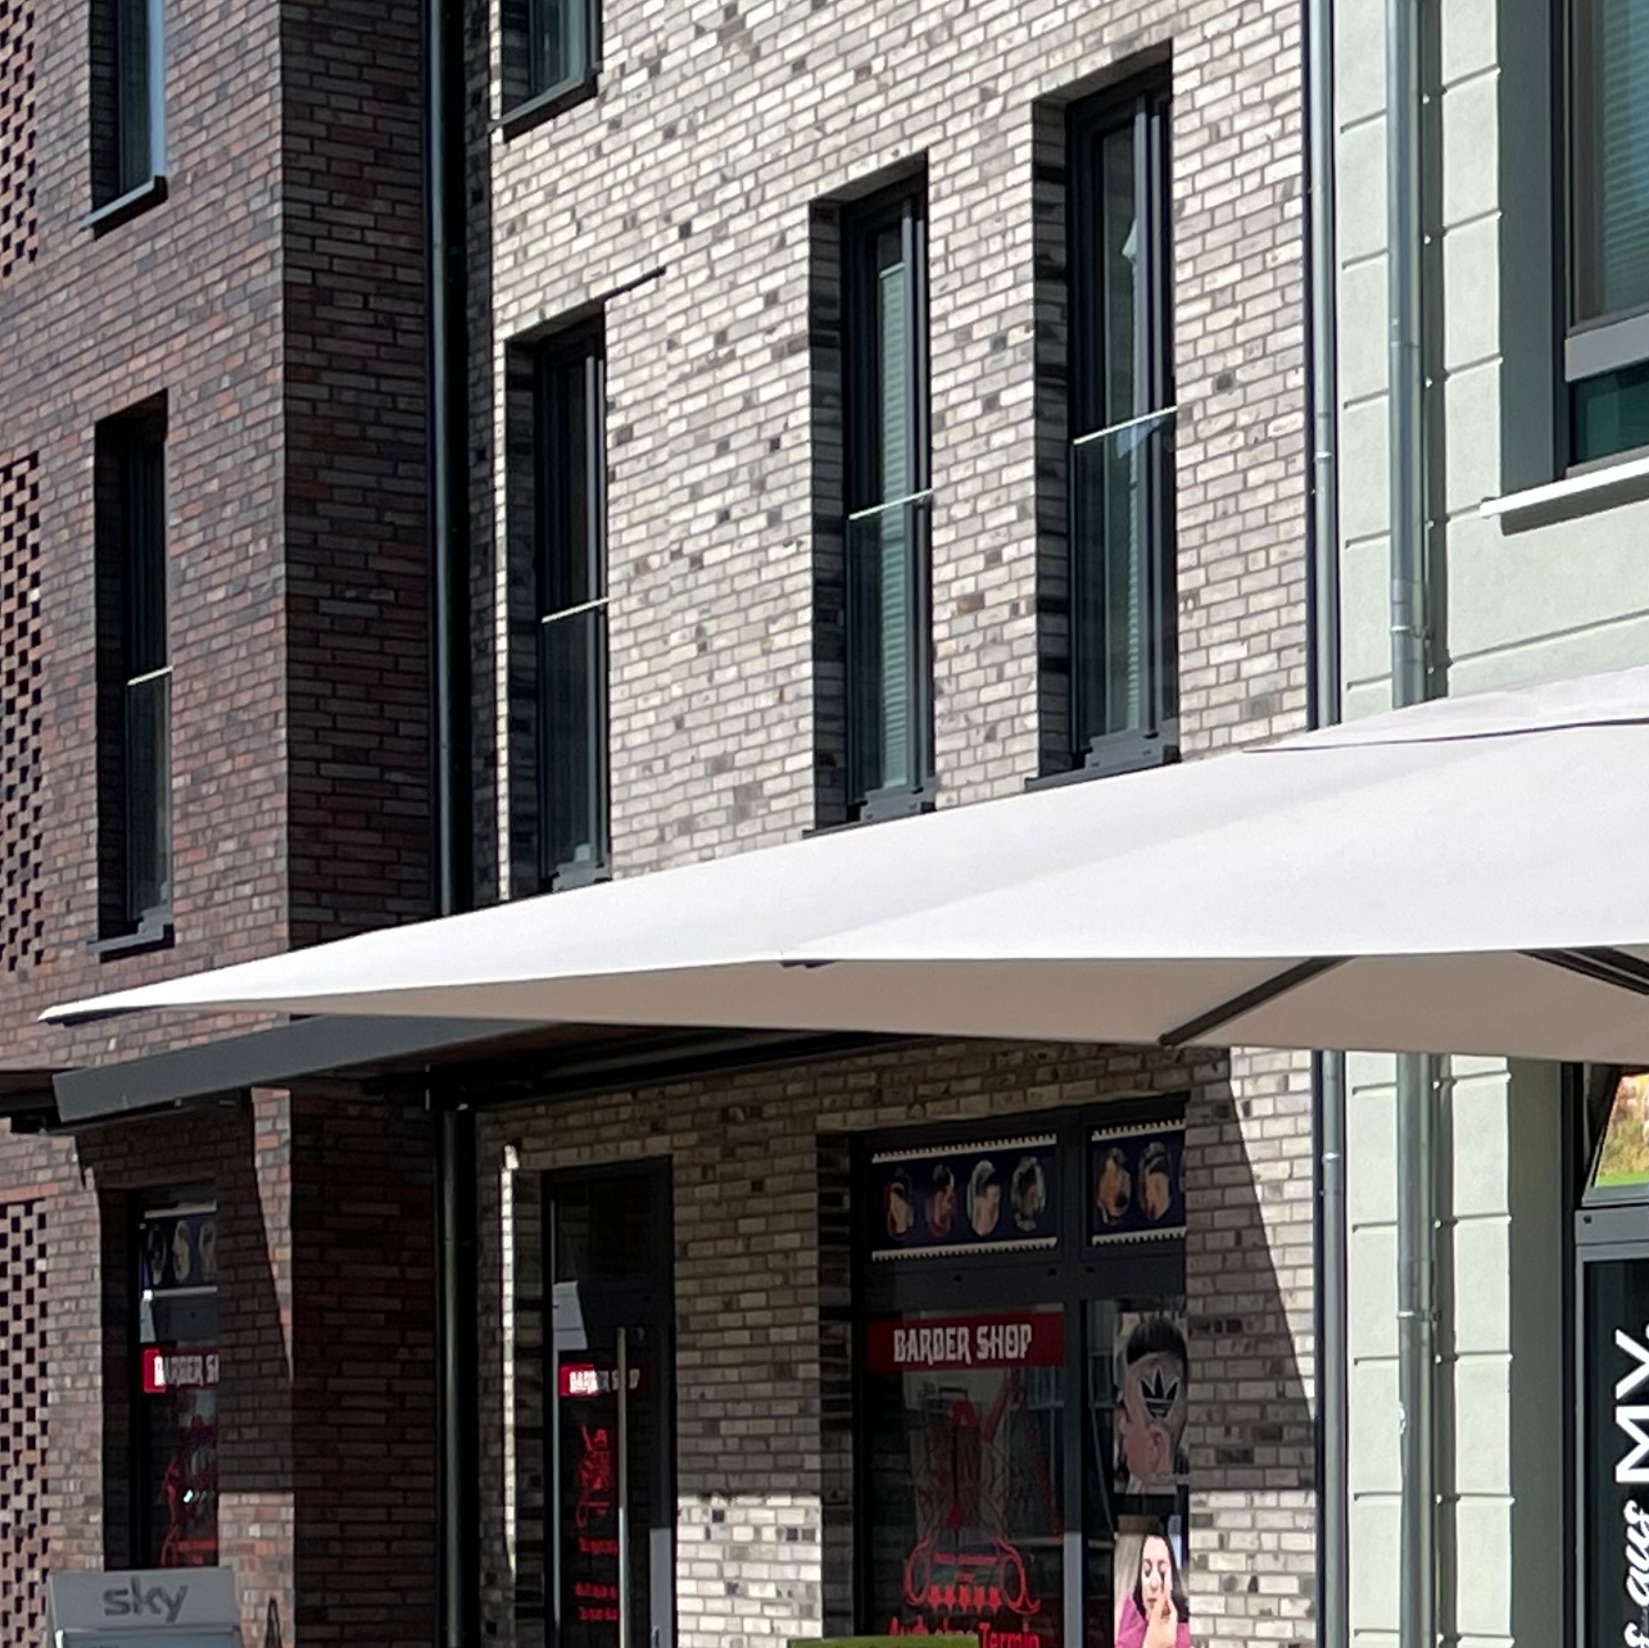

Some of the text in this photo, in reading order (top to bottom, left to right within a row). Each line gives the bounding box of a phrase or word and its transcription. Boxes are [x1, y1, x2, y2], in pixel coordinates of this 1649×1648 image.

[893, 1323, 1033, 1367] BARBER SHOP
[102, 1575, 189, 1625] sky
